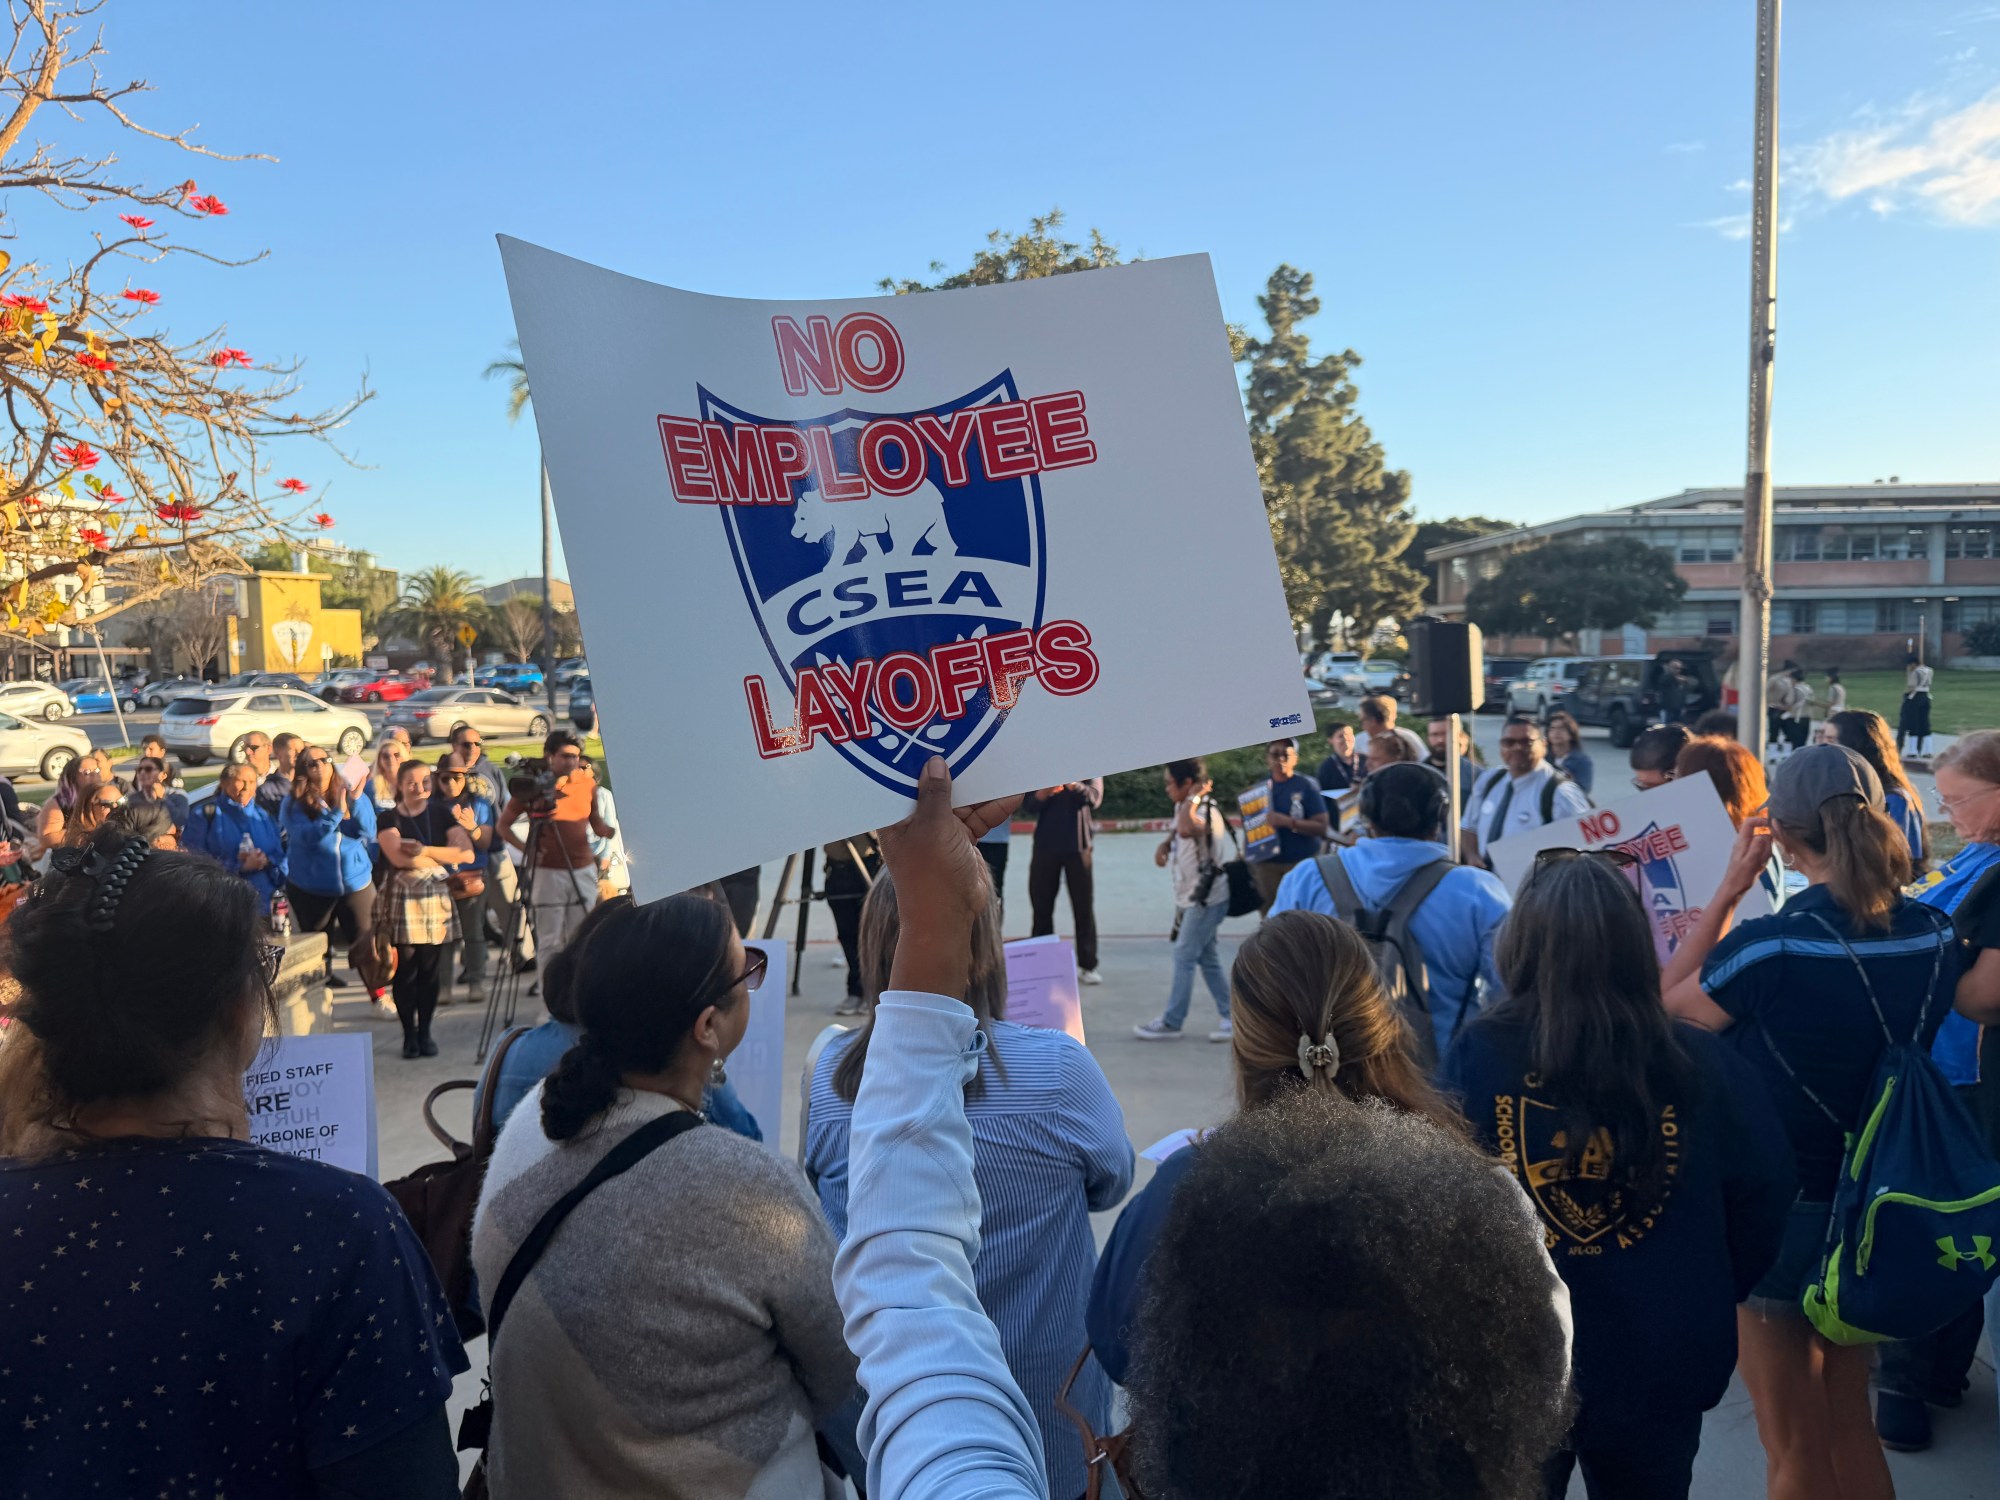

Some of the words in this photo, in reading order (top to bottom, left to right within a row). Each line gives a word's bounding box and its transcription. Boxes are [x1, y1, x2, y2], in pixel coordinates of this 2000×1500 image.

[772, 311, 905, 397] NO
[656, 390, 1098, 506] EMPLOYEE
[786, 569, 1003, 637] CSEA
[743, 619, 1100, 760] LAYOFFS
[1577, 810, 1621, 846] NO
[286, 1062, 334, 1080] STAFF
[319, 1124, 340, 1138] OF
